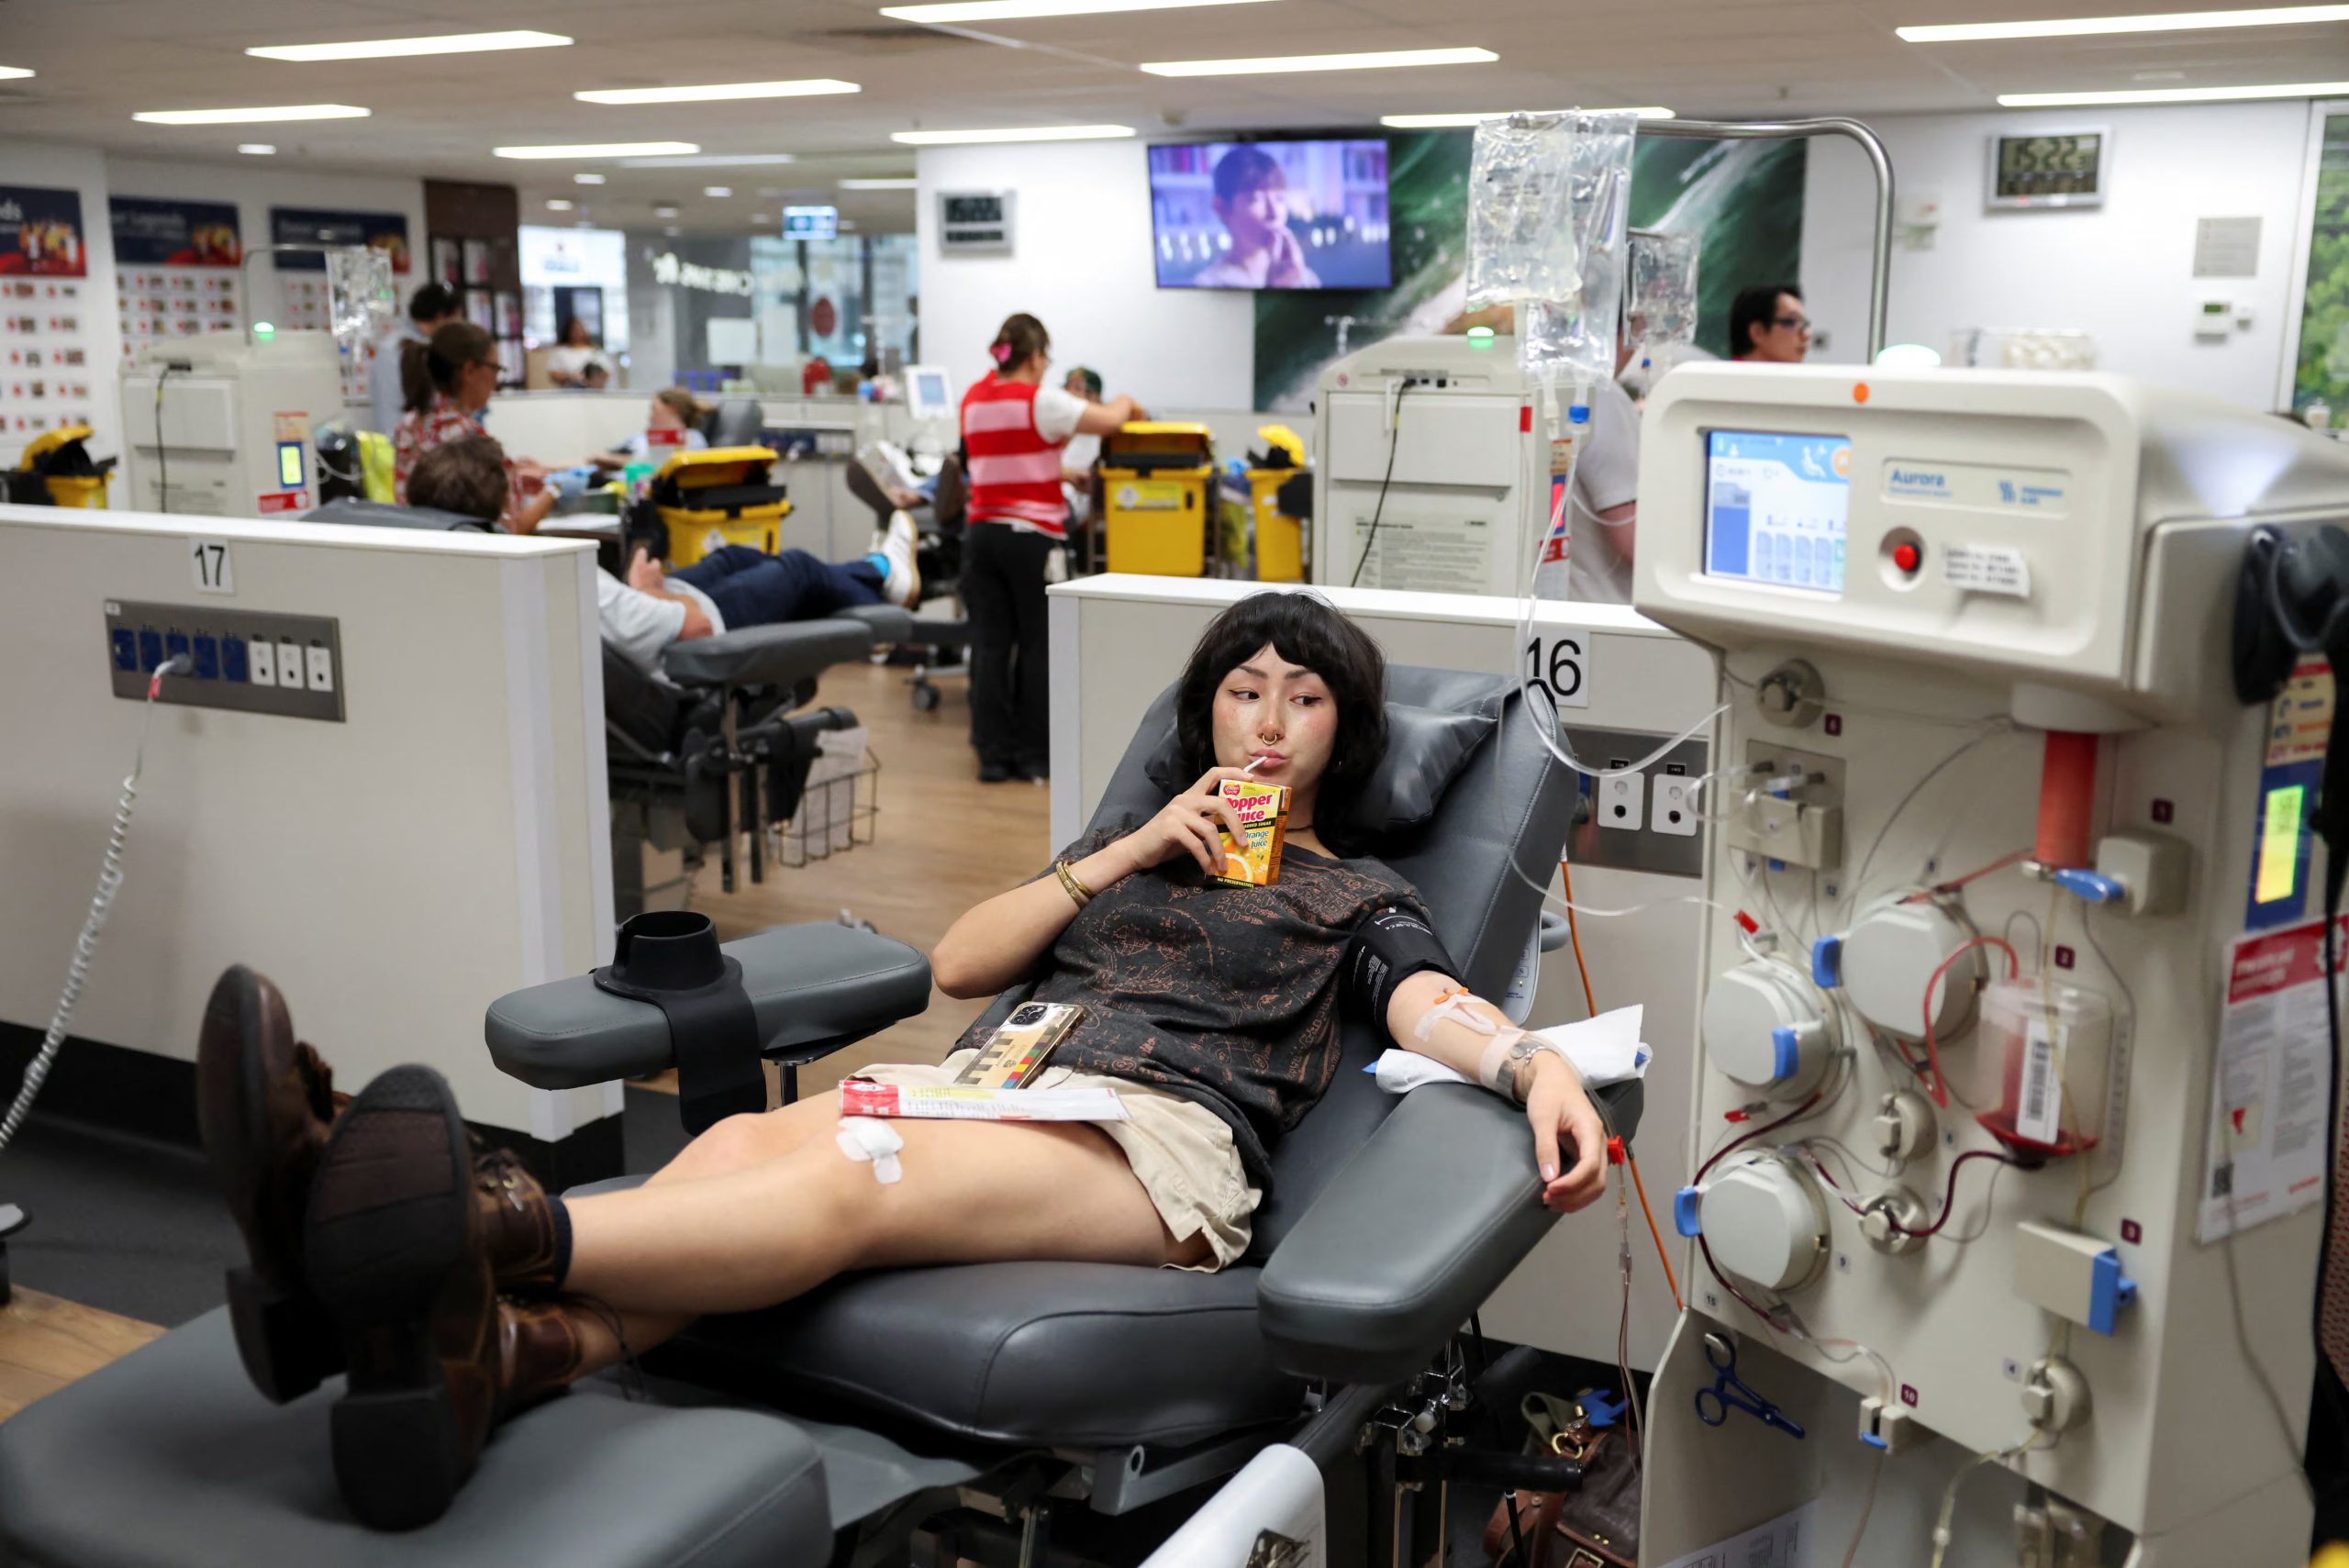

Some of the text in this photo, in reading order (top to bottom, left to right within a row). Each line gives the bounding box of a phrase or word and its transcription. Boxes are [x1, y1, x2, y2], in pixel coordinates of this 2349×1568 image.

[1891, 469, 1945, 487] Aurora
[195, 543, 225, 586] 17
[1527, 637, 1581, 696] 16
[1227, 794, 1273, 812] opper
[1238, 810, 1264, 822] uice
[1251, 840, 1268, 849] Juice
[1224, 878, 1254, 888] PRESERVATIVES
